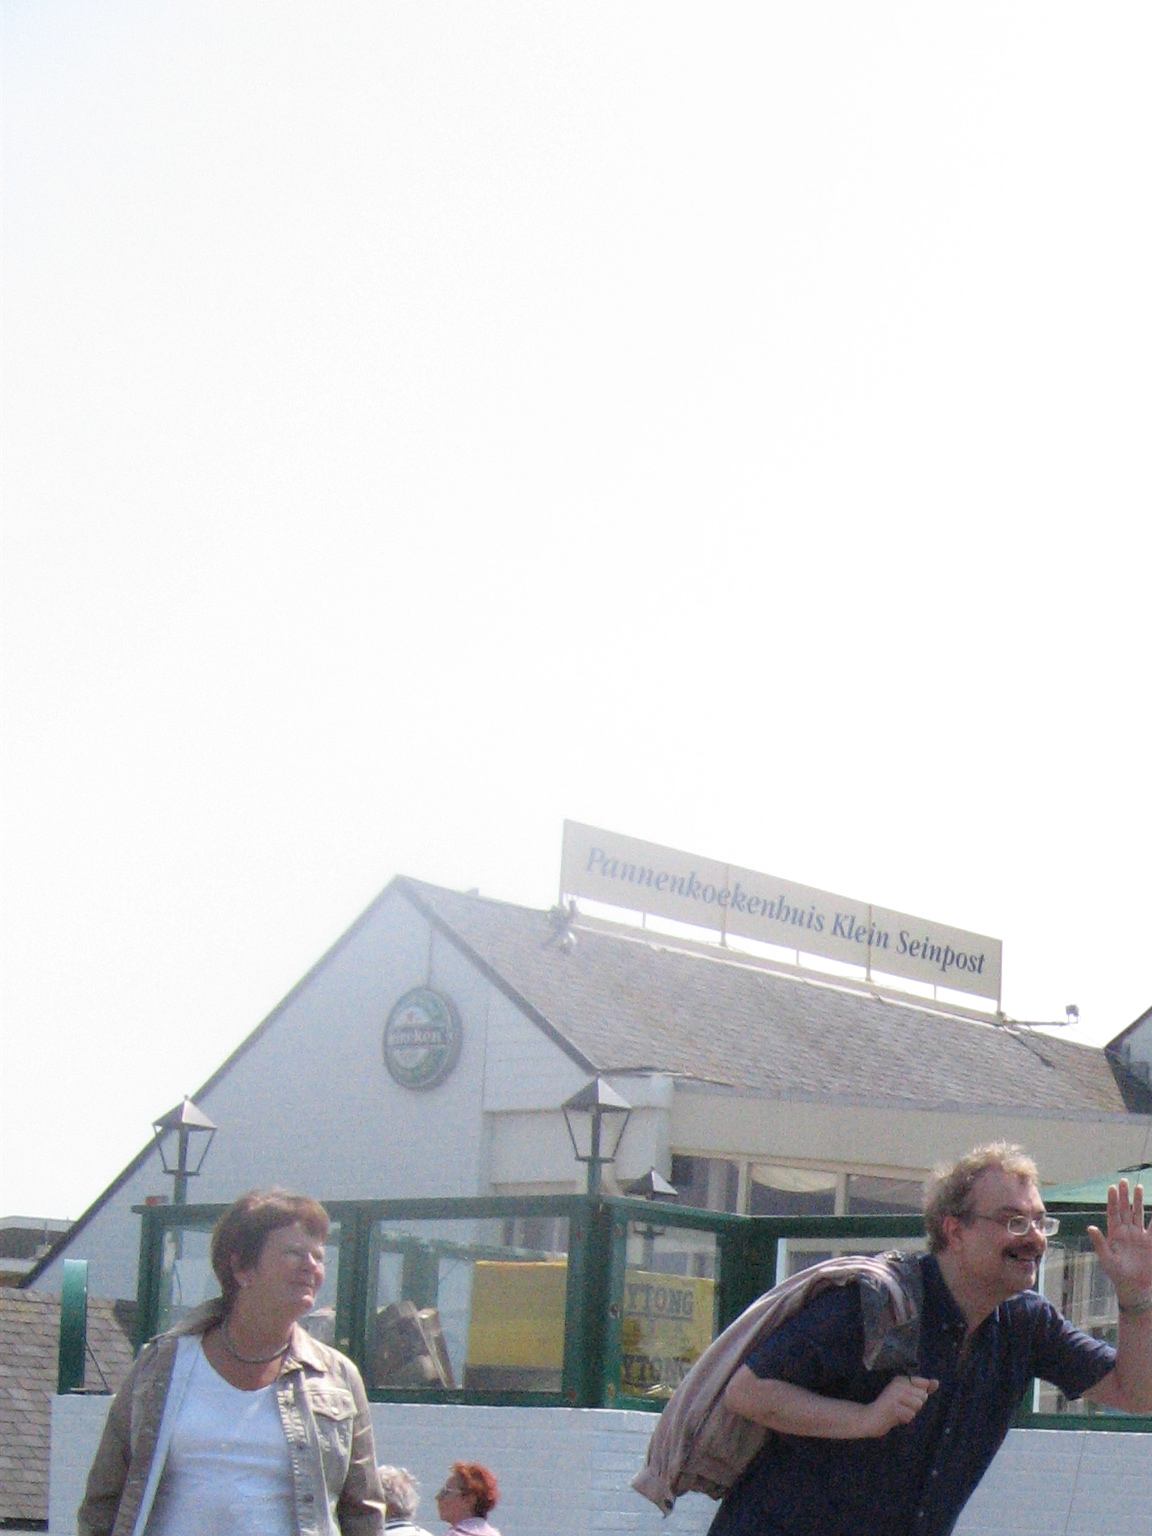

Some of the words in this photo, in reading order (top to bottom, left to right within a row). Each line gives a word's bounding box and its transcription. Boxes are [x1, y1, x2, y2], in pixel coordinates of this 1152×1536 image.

[586, 847, 825, 932] Pannenkoekenhuis
[831, 912, 889, 949] Klein
[896, 930, 985, 974] Seinpost
